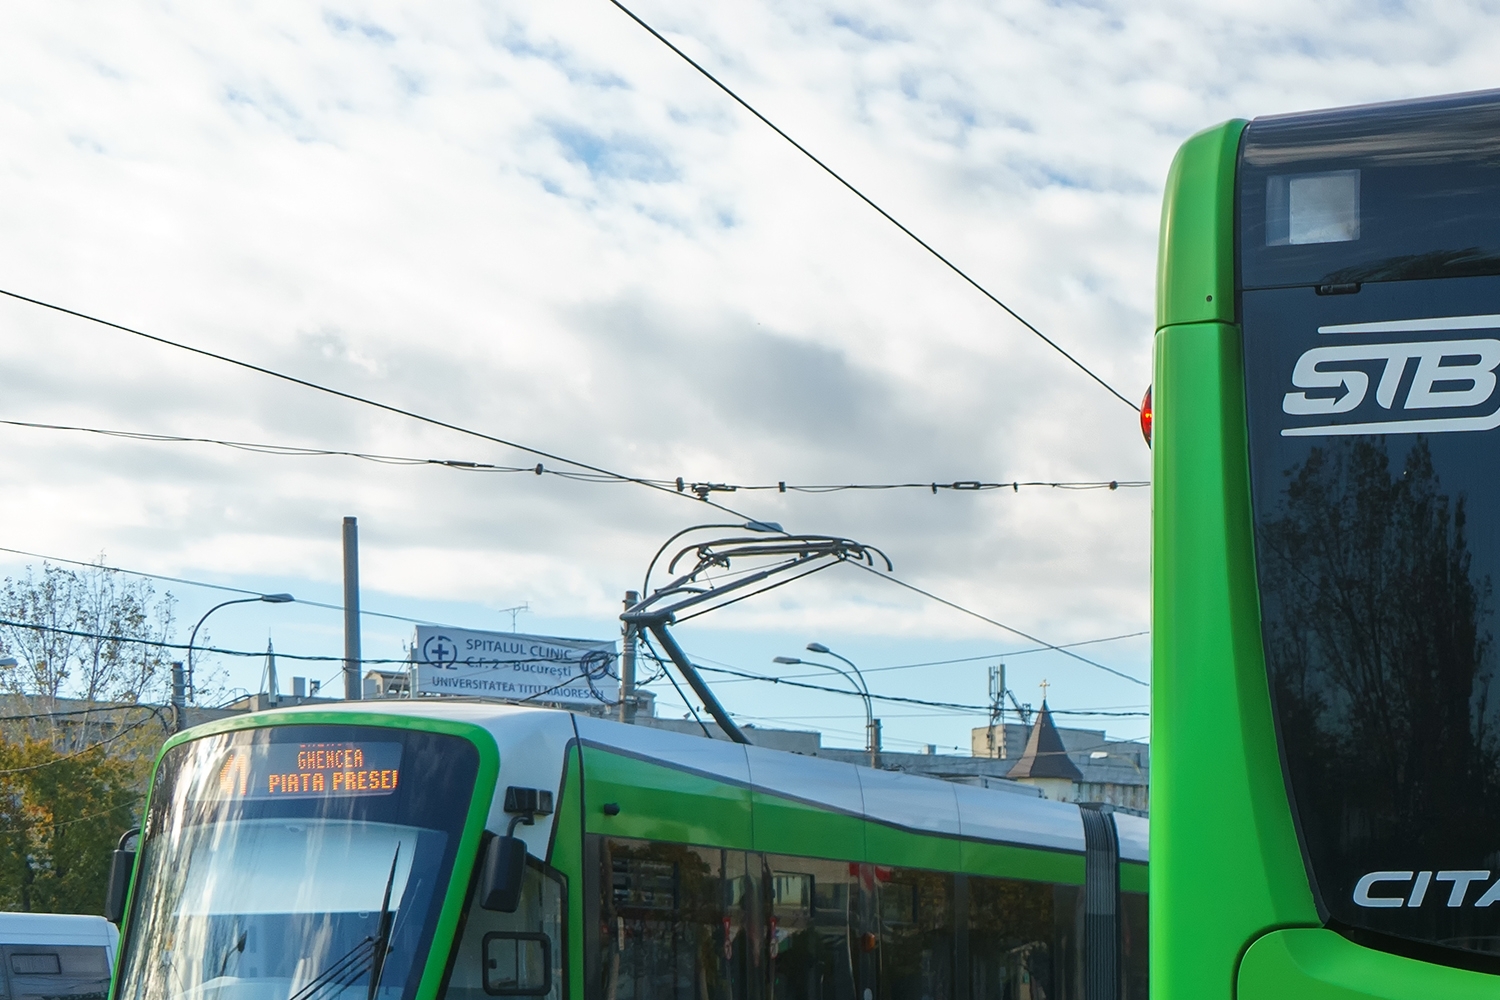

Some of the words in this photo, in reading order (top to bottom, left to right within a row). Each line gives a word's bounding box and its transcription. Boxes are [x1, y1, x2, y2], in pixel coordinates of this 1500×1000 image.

[466, 638, 527, 656] SPITALUL
[529, 645, 572, 661] CLINIC
[492, 658, 499, 670] 2
[432, 675, 516, 693] UNIVERSITATEA
[518, 682, 542, 695] TITU
[297, 749, 364, 770] GHENCEA
[268, 772, 325, 794] PIATA
[332, 769, 399, 792] PRESEI
